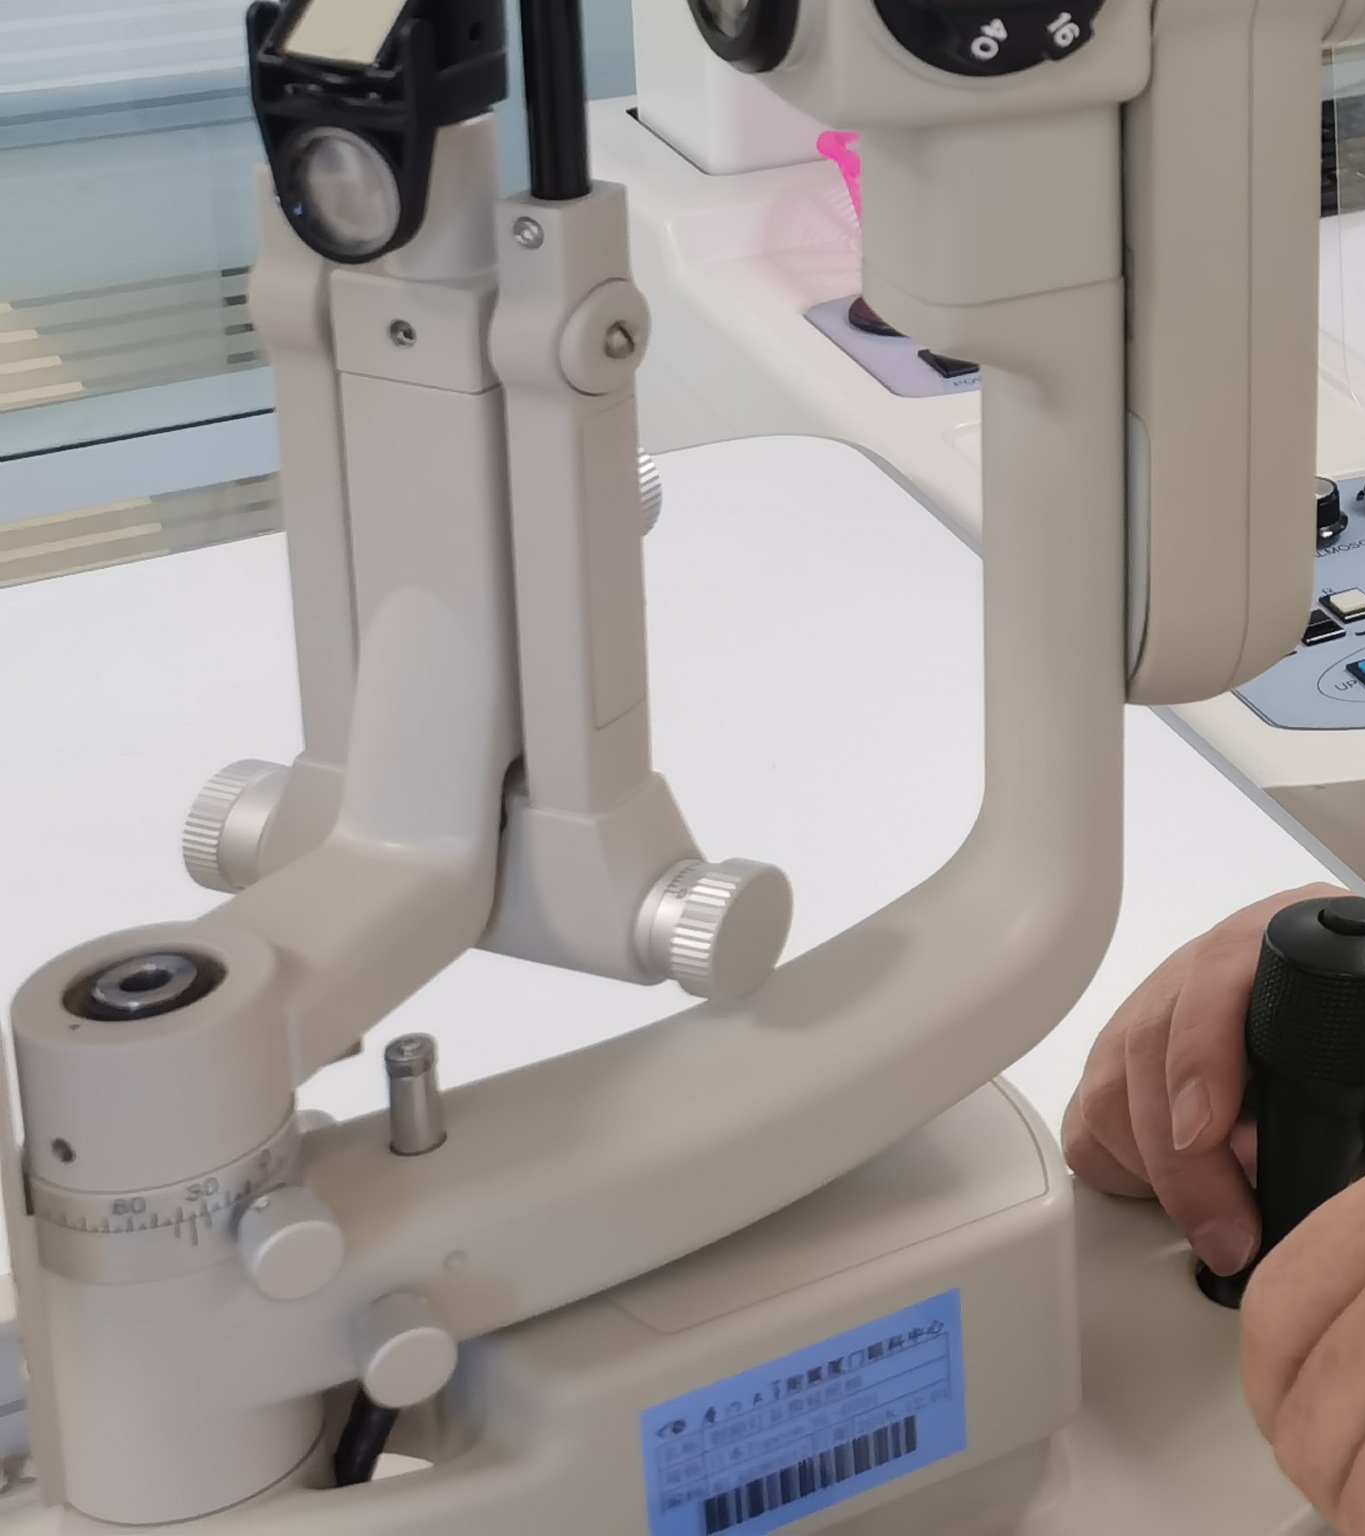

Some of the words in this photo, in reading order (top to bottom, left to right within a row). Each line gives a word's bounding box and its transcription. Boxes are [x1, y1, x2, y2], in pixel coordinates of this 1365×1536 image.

[970, 18, 1008, 61] 40
[1047, 11, 1080, 48] 16
[1334, 679, 1359, 692] UP
